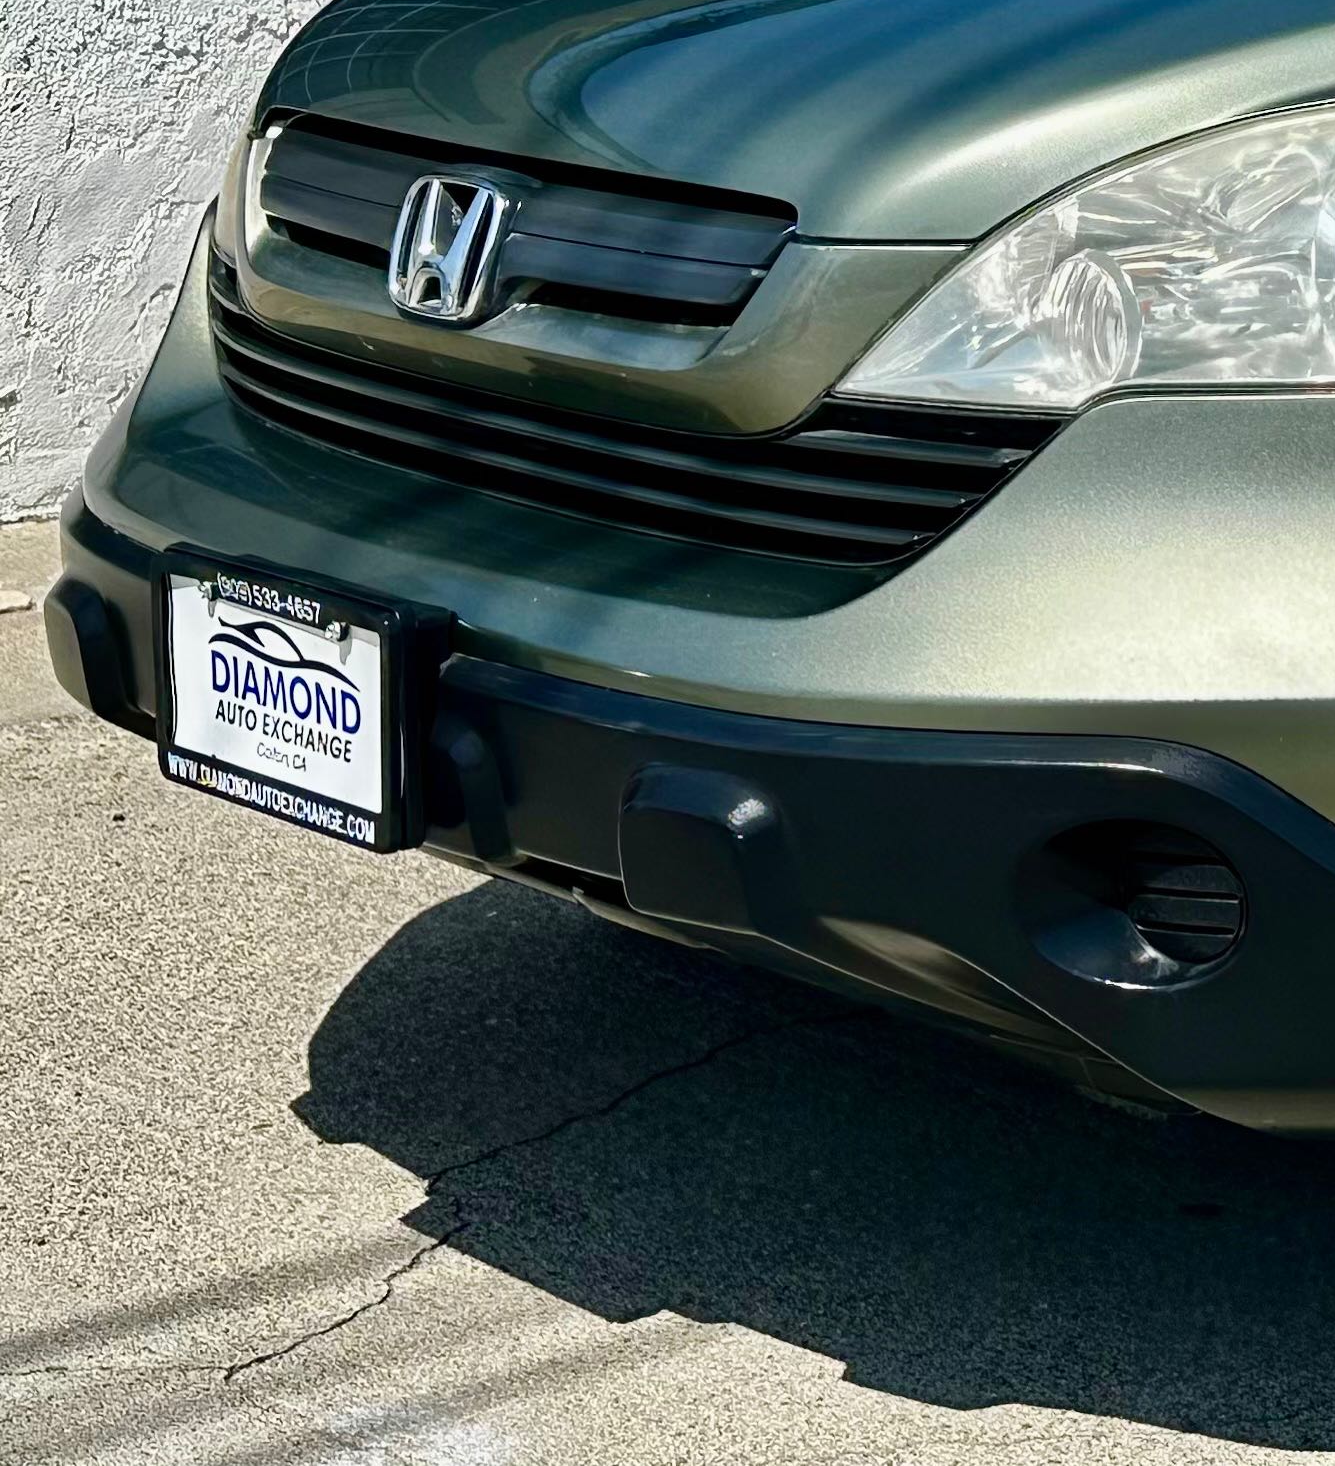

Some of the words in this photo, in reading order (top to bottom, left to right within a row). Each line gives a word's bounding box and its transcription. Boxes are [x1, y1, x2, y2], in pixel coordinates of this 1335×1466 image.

[211, 649, 361, 734] DIAMOND
[215, 700, 257, 731] AUTO
[262, 713, 352, 763] EXCHANGE
